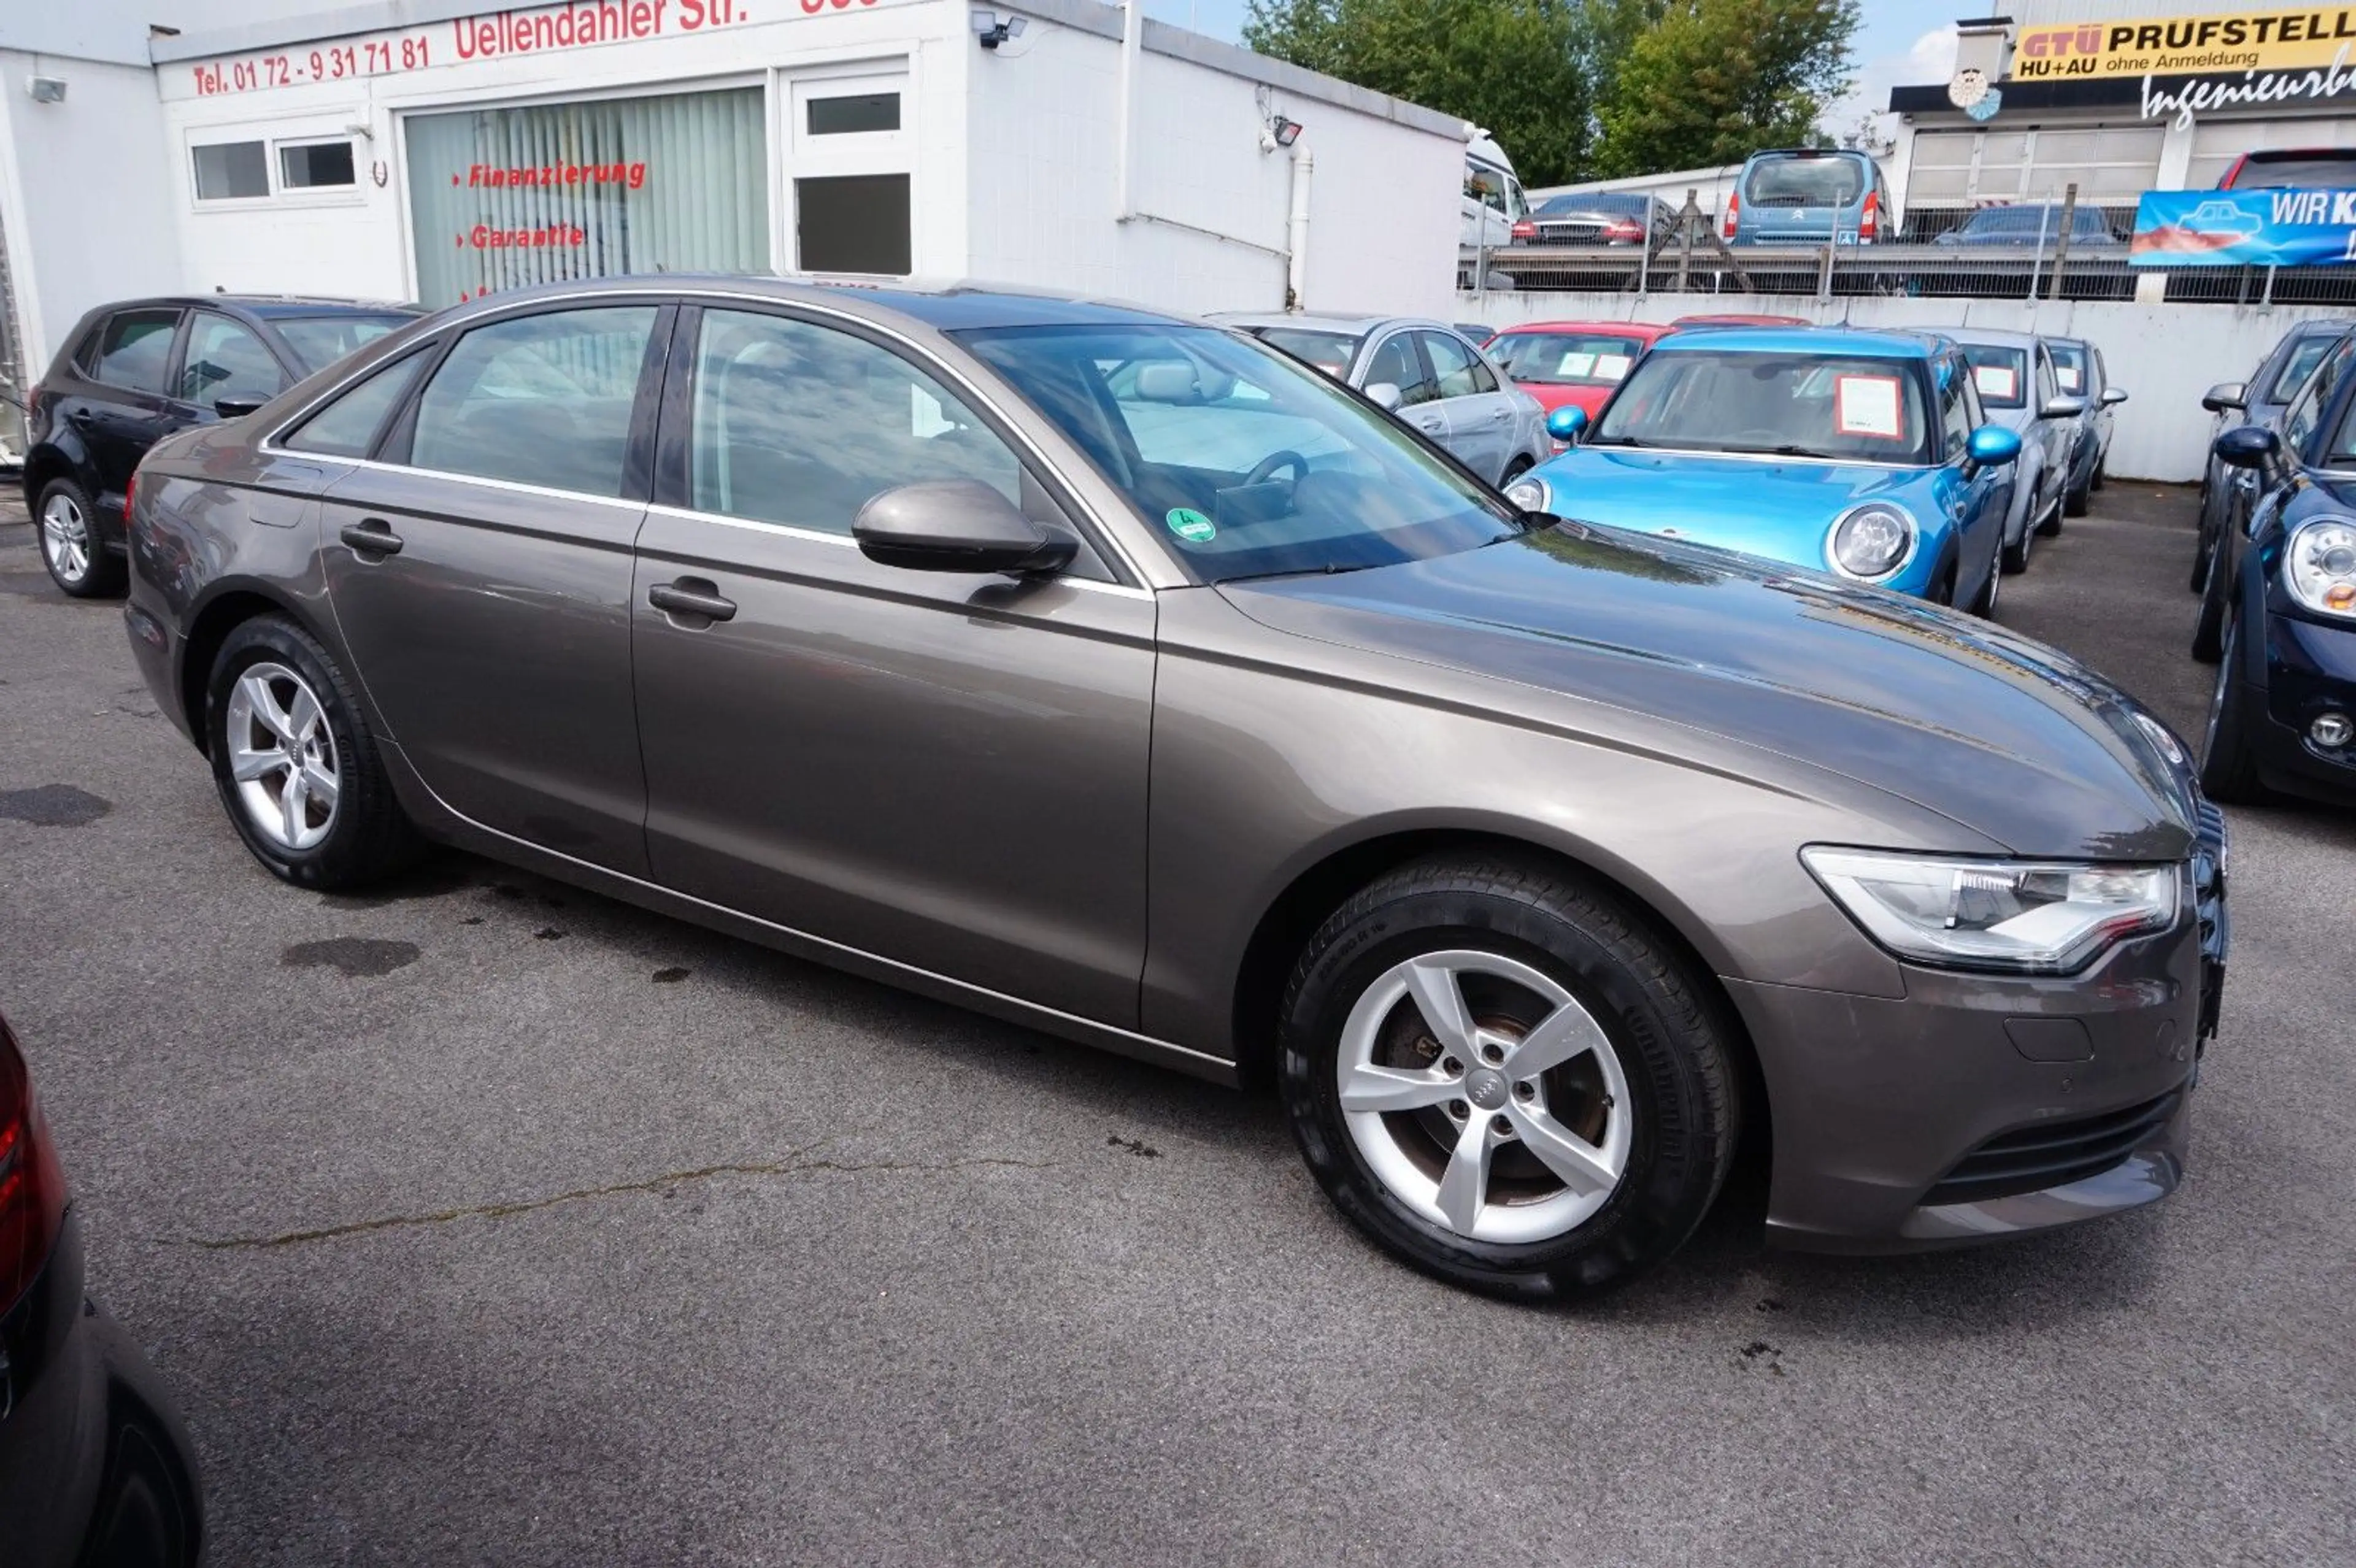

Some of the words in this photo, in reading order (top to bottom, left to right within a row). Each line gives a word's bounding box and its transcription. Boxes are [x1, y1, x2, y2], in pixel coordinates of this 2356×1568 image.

[453, 0, 668, 59] Uellendahler
[679, 0, 747, 30] Str.
[2023, 24, 2103, 57] GTÜ
[2108, 12, 2356, 52] PRÜFSTELL
[194, 63, 228, 95] Tel.
[234, 60, 256, 91] 01
[263, 56, 290, 86] 72
[310, 52, 323, 80] 9
[330, 46, 356, 78] 31
[364, 41, 391, 73] 71
[402, 36, 429, 69] 81
[2020, 58, 2097, 76] HU+AU
[2106, 56, 2150, 71] ohne
[2155, 51, 2260, 69] Anmeldung
[469, 158, 646, 189] Finanzierung
[2272, 192, 2328, 225] WIR
[2331, 191, 2356, 225] K
[471, 221, 583, 248] Garantie
